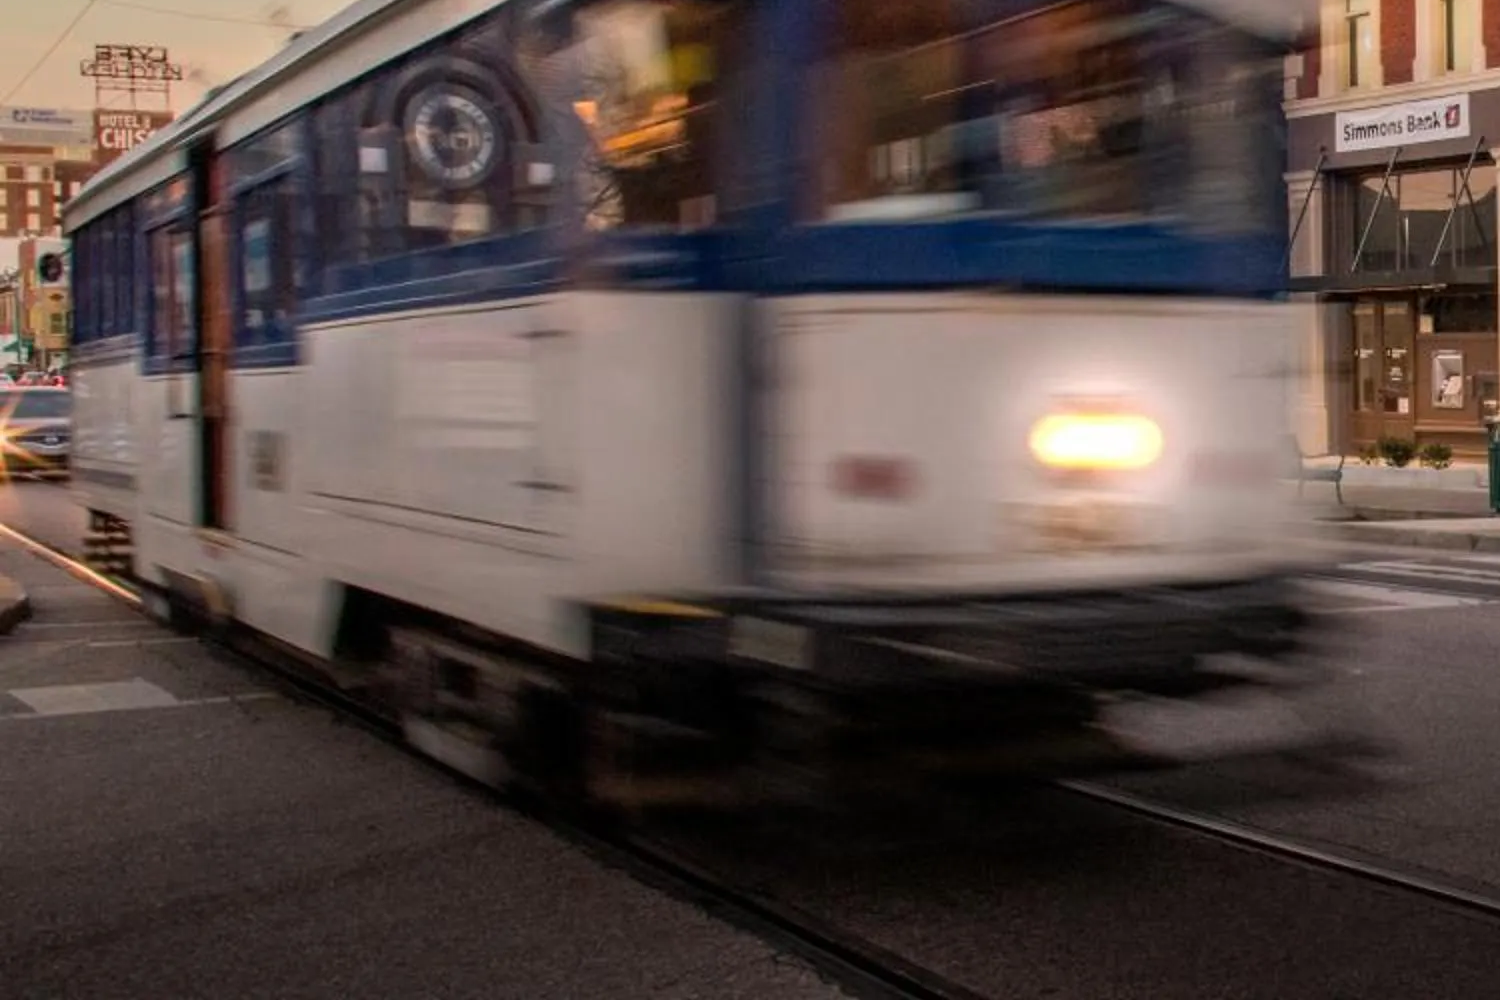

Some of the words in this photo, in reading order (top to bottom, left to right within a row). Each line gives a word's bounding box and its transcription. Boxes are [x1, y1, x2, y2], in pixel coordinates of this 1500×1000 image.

[101, 129, 156, 149] CHIS
[1343, 119, 1403, 142] Simmons
[1407, 111, 1441, 133] Bank
